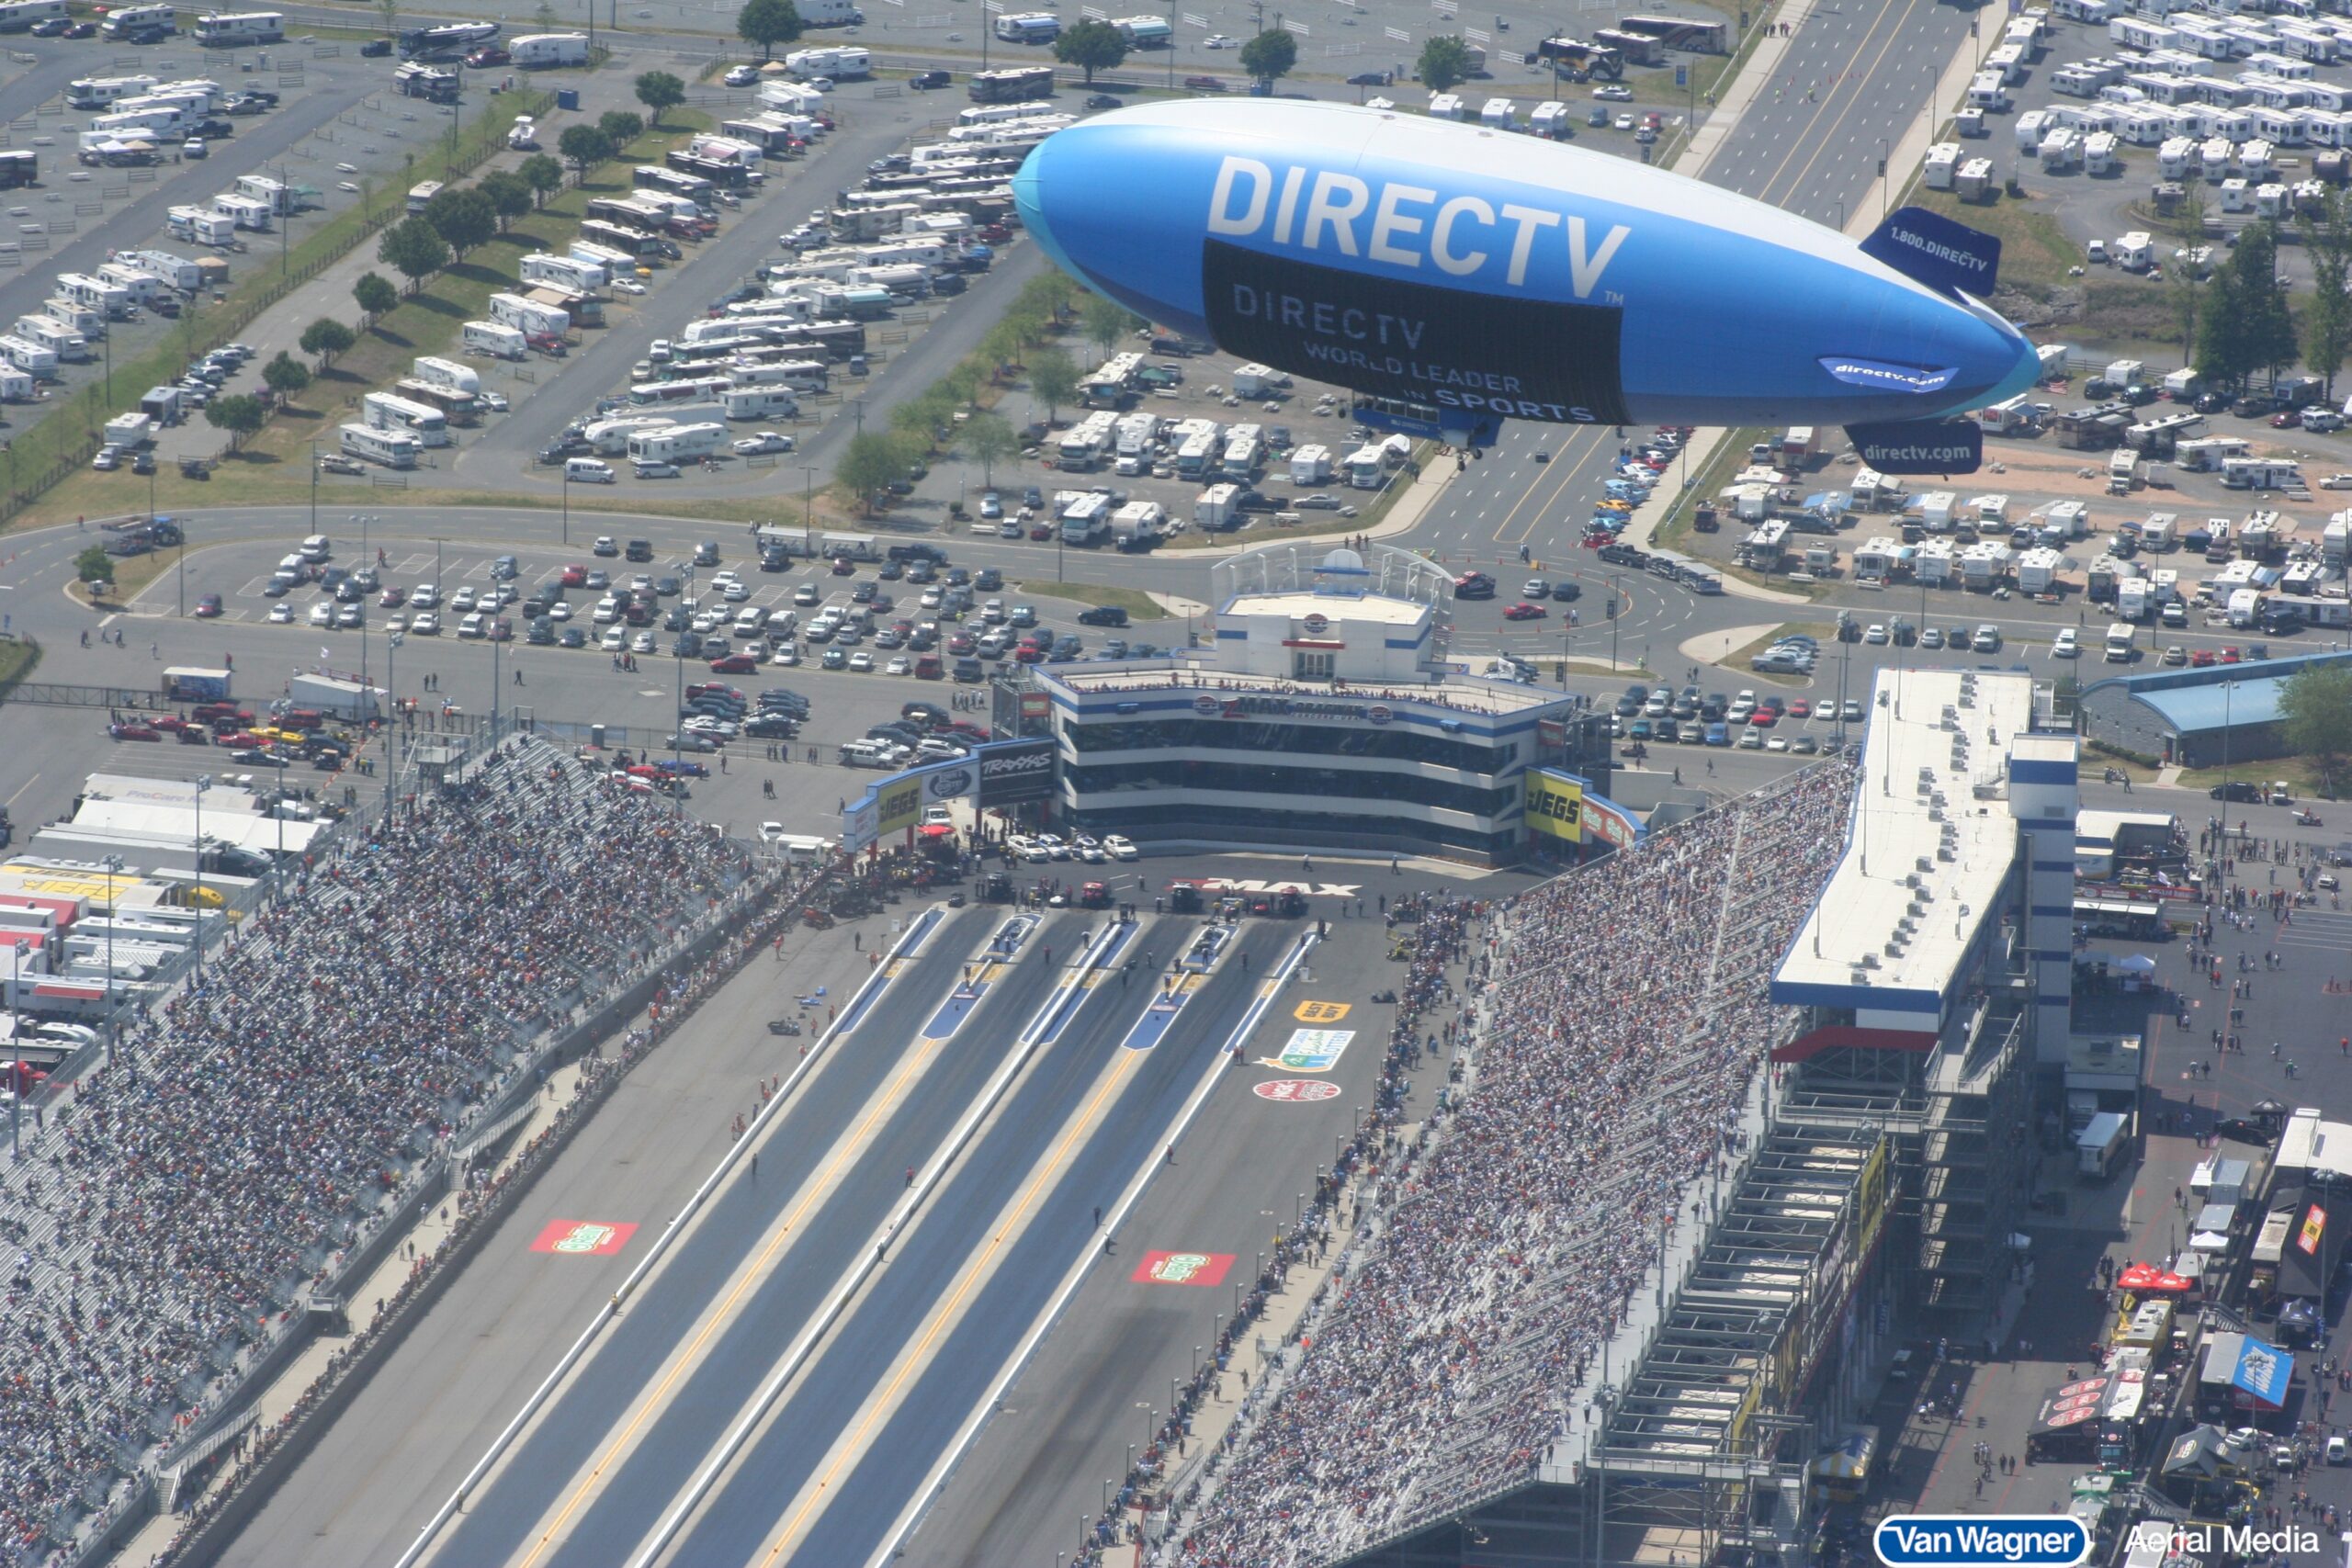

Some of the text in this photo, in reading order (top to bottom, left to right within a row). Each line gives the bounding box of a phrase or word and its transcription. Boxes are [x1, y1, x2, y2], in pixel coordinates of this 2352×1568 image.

[1206, 155, 1632, 299] DIRECTV
[1891, 227, 1987, 271] 1.800.DIRECTV
[1234, 283, 1426, 350] DIRECTV
[1304, 341, 1521, 395] WORLD LEADER
[1836, 365, 1945, 385] directv.com
[1403, 389, 1596, 423] IN SPORTS
[1865, 444, 1971, 462] directv.com
[983, 752, 1051, 774] TRAXXAS
[880, 789, 918, 823] JEGS
[1526, 788, 1580, 825] JEGS
[33, 879, 129, 901] JEGS
[1302, 1002, 1324, 1018] BEST
[1321, 1005, 1341, 1018] BUY
